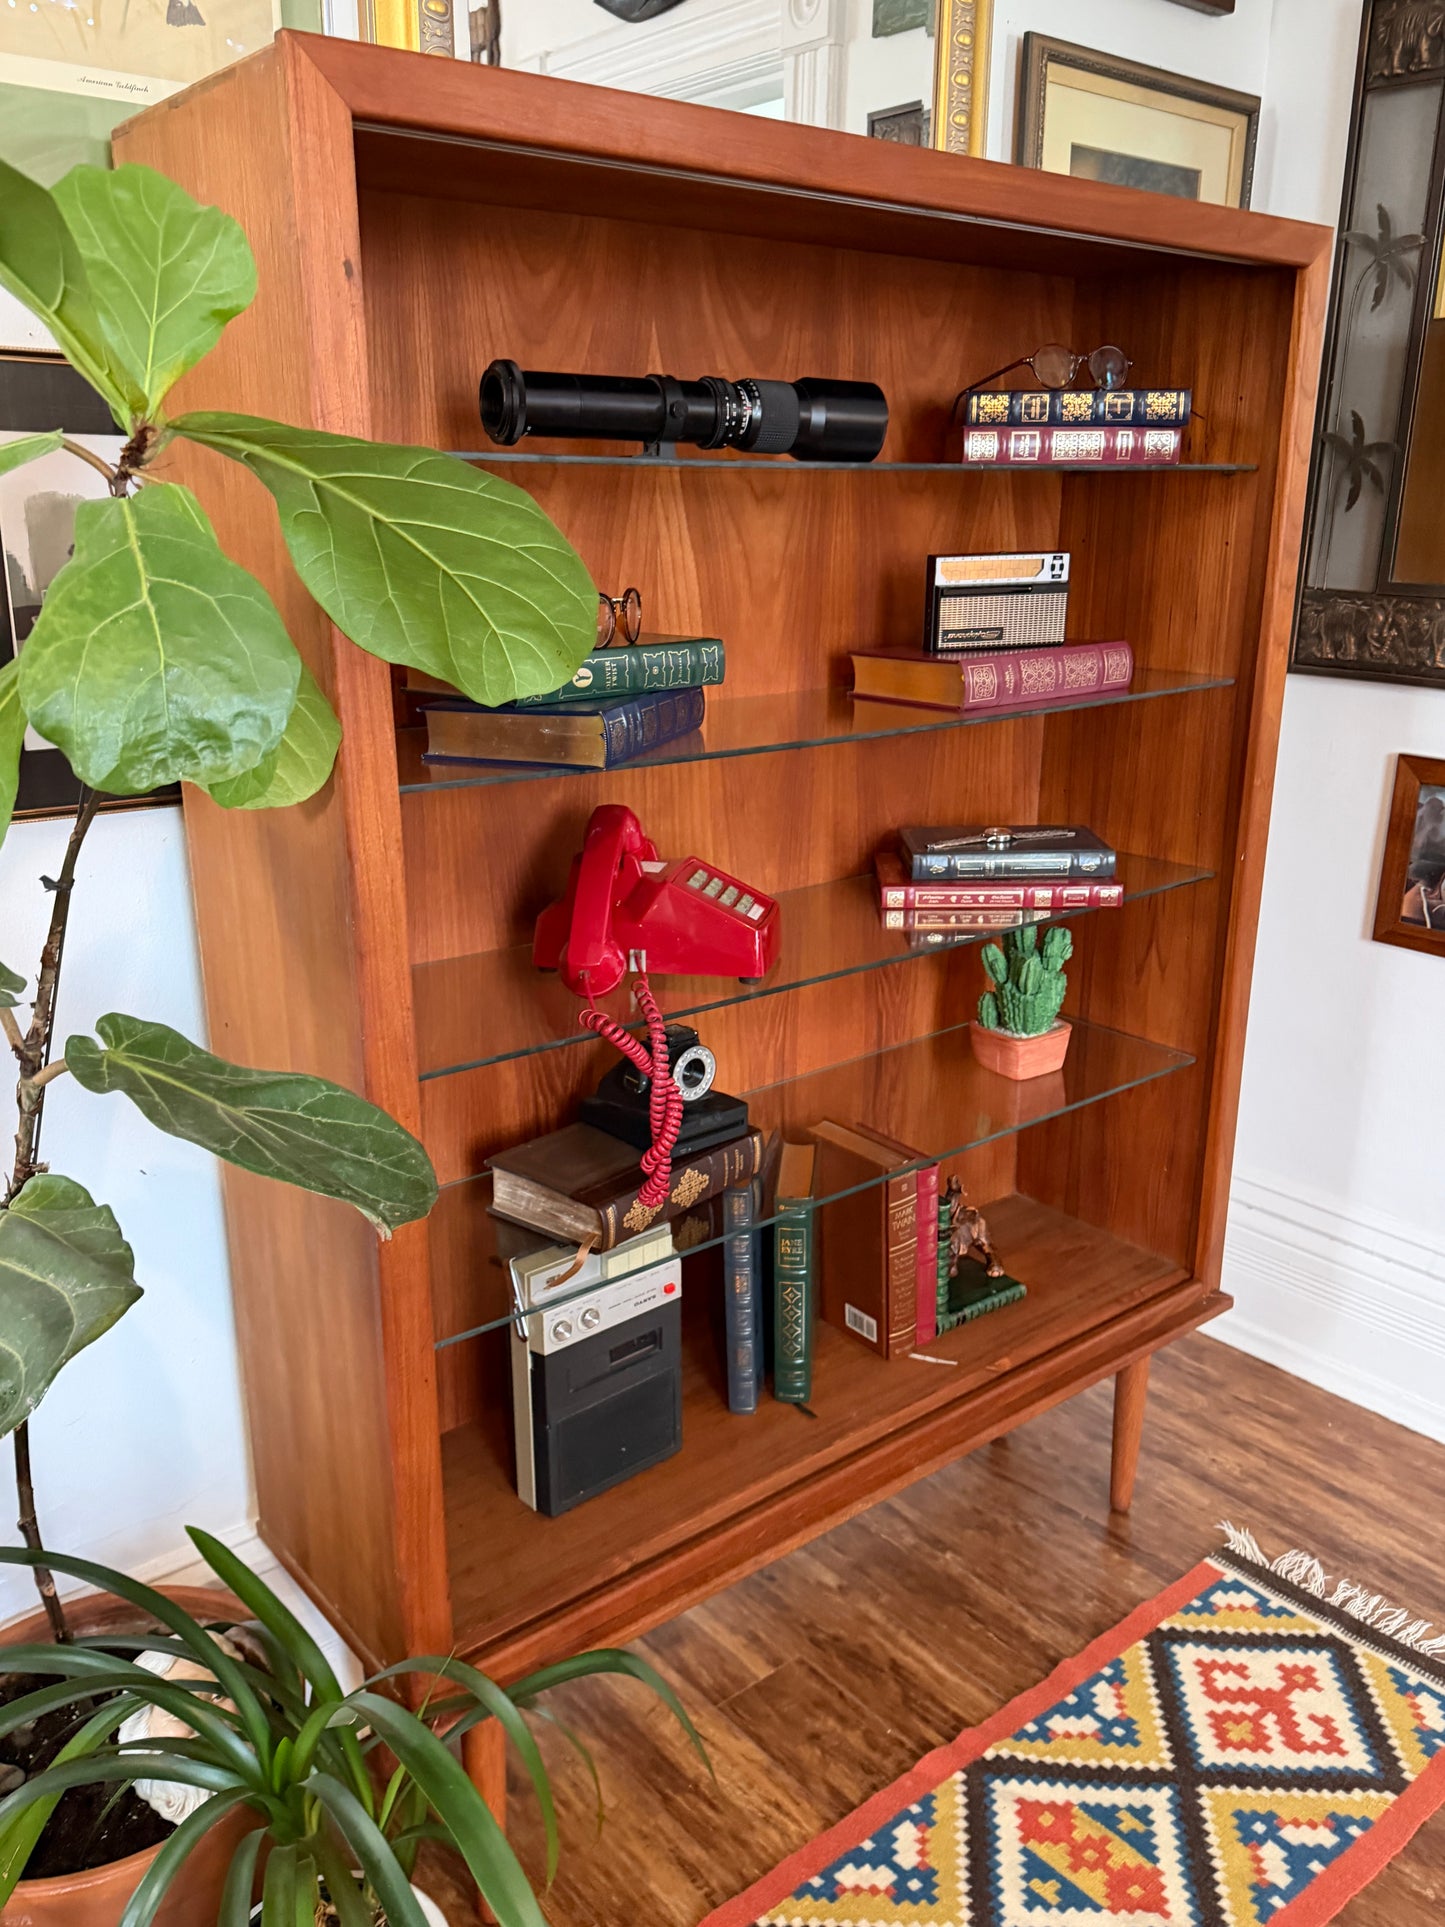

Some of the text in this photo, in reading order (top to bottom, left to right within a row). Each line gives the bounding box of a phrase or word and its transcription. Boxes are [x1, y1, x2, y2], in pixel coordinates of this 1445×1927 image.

[77, 76, 149, 93] American Goldfinch
[894, 1206, 913, 1220] MARK
[892, 1213, 916, 1231] TWAIN
[781, 1238, 803, 1246] JANE
[781, 1246, 803, 1254] EYRE
